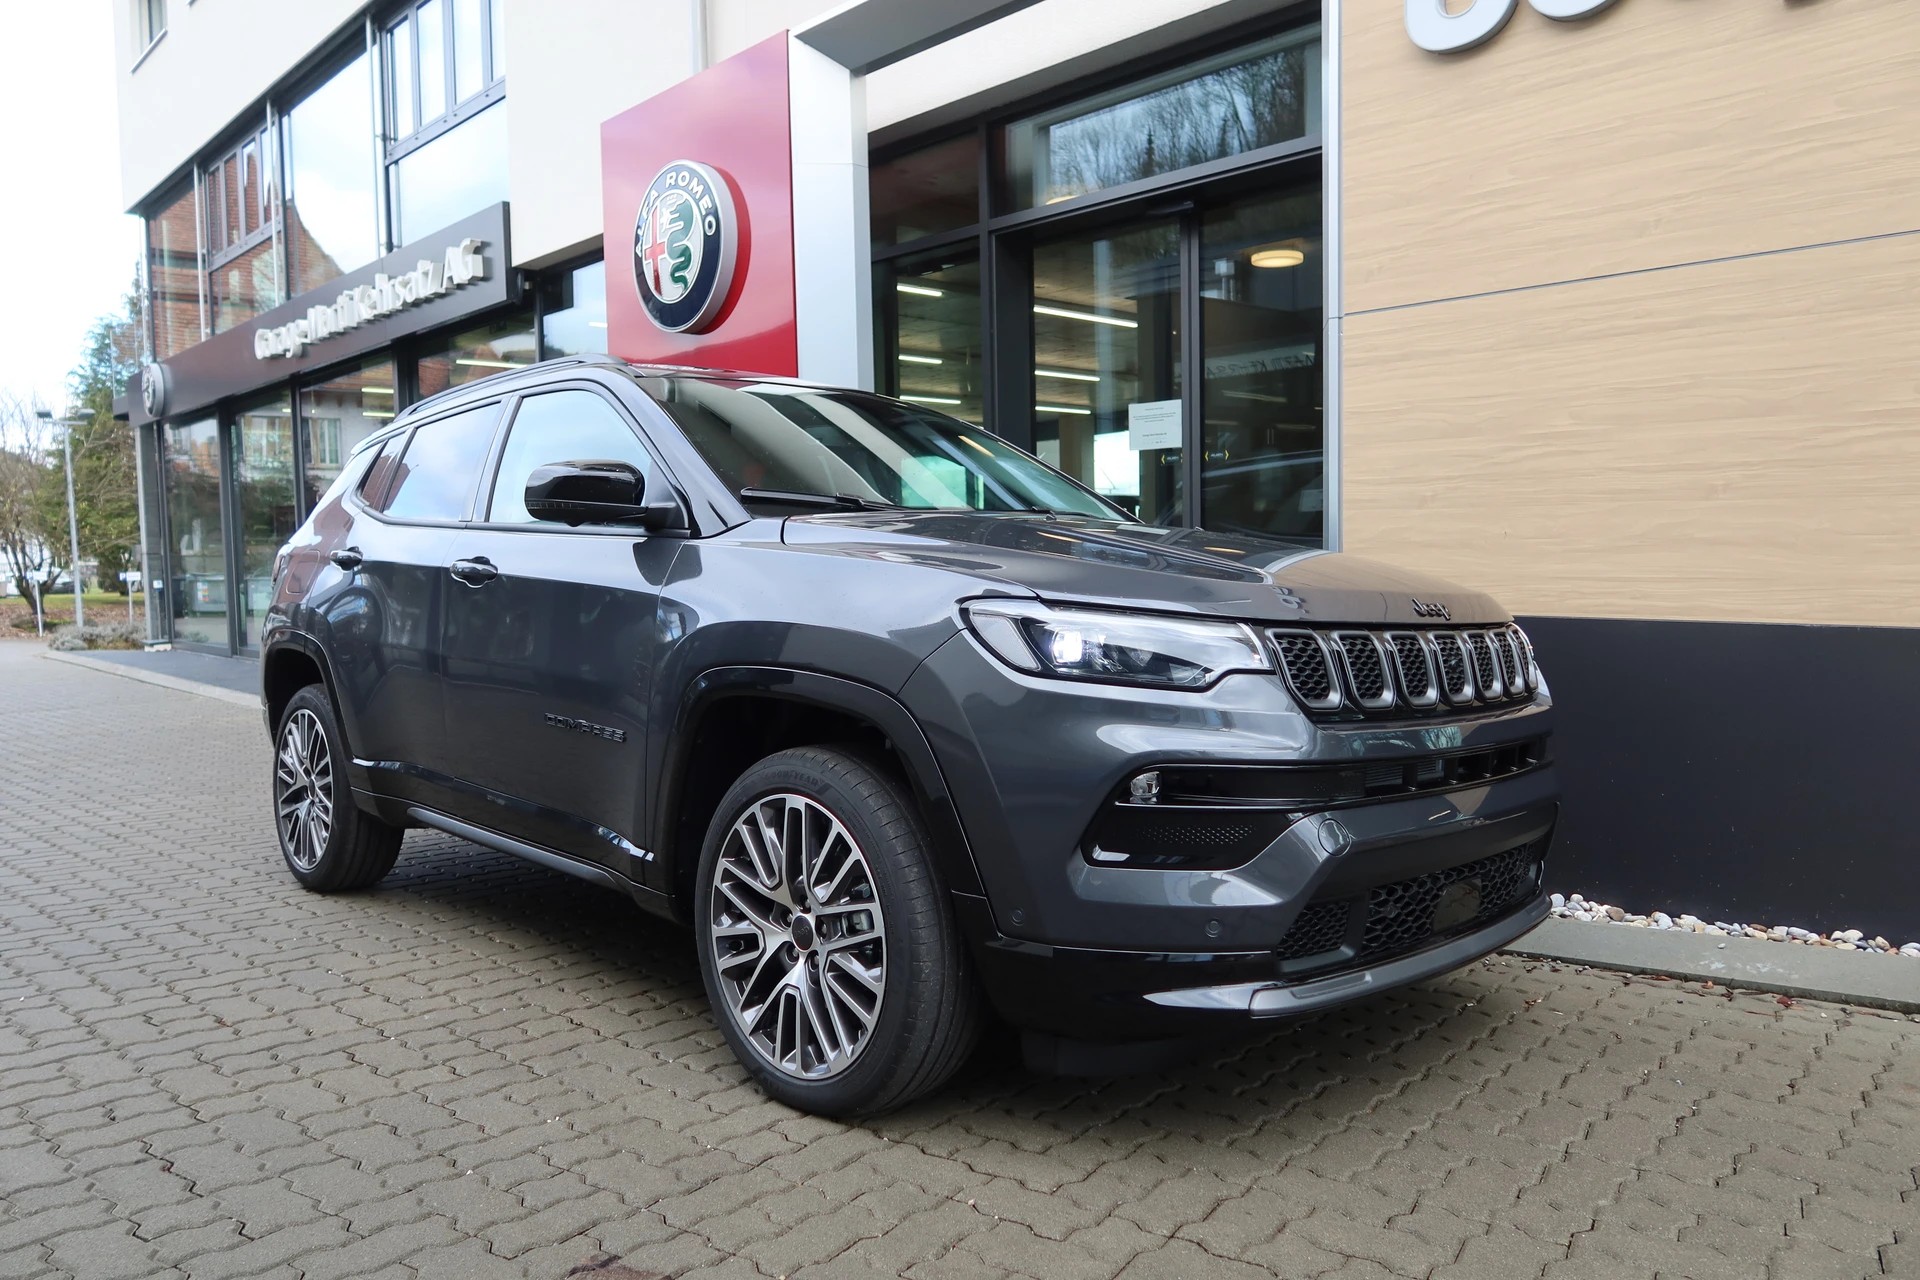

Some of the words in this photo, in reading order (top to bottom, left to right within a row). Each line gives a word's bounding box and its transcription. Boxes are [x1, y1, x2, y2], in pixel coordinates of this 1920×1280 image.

[635, 188, 659, 258] ALFA
[665, 170, 717, 236] ROMEO
[254, 318, 311, 359] Garage
[442, 238, 484, 289] AG
[1411, 597, 1452, 621] Jeep
